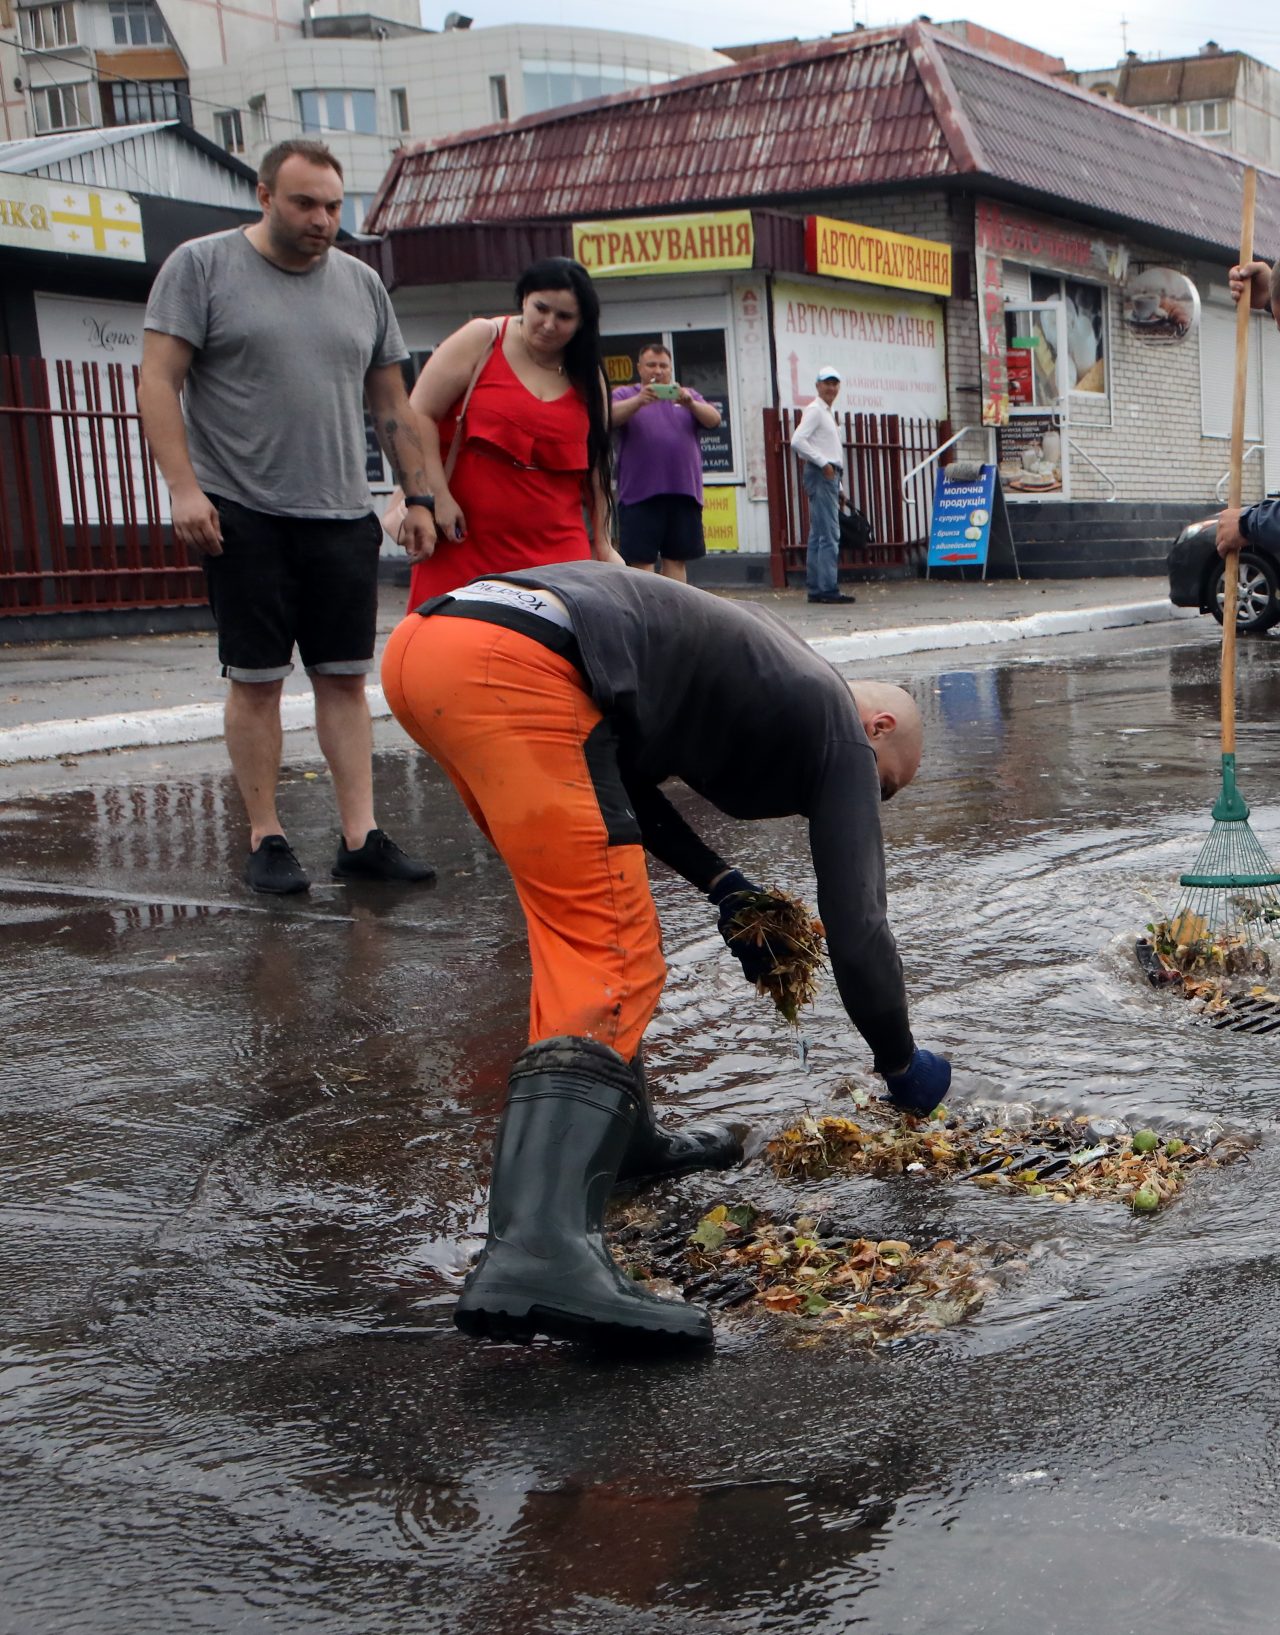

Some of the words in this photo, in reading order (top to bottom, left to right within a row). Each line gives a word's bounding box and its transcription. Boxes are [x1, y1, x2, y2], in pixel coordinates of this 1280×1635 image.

[578, 223, 751, 268] СТРАХУВАННЯ
[819, 227, 950, 287] АВТОСТРАХУВАННЯ
[785, 301, 936, 348] АВТОСТРАХУВАННЯ
[608, 358, 631, 379] ВТО
[940, 496, 986, 509] продукція
[944, 486, 984, 495] молочна
